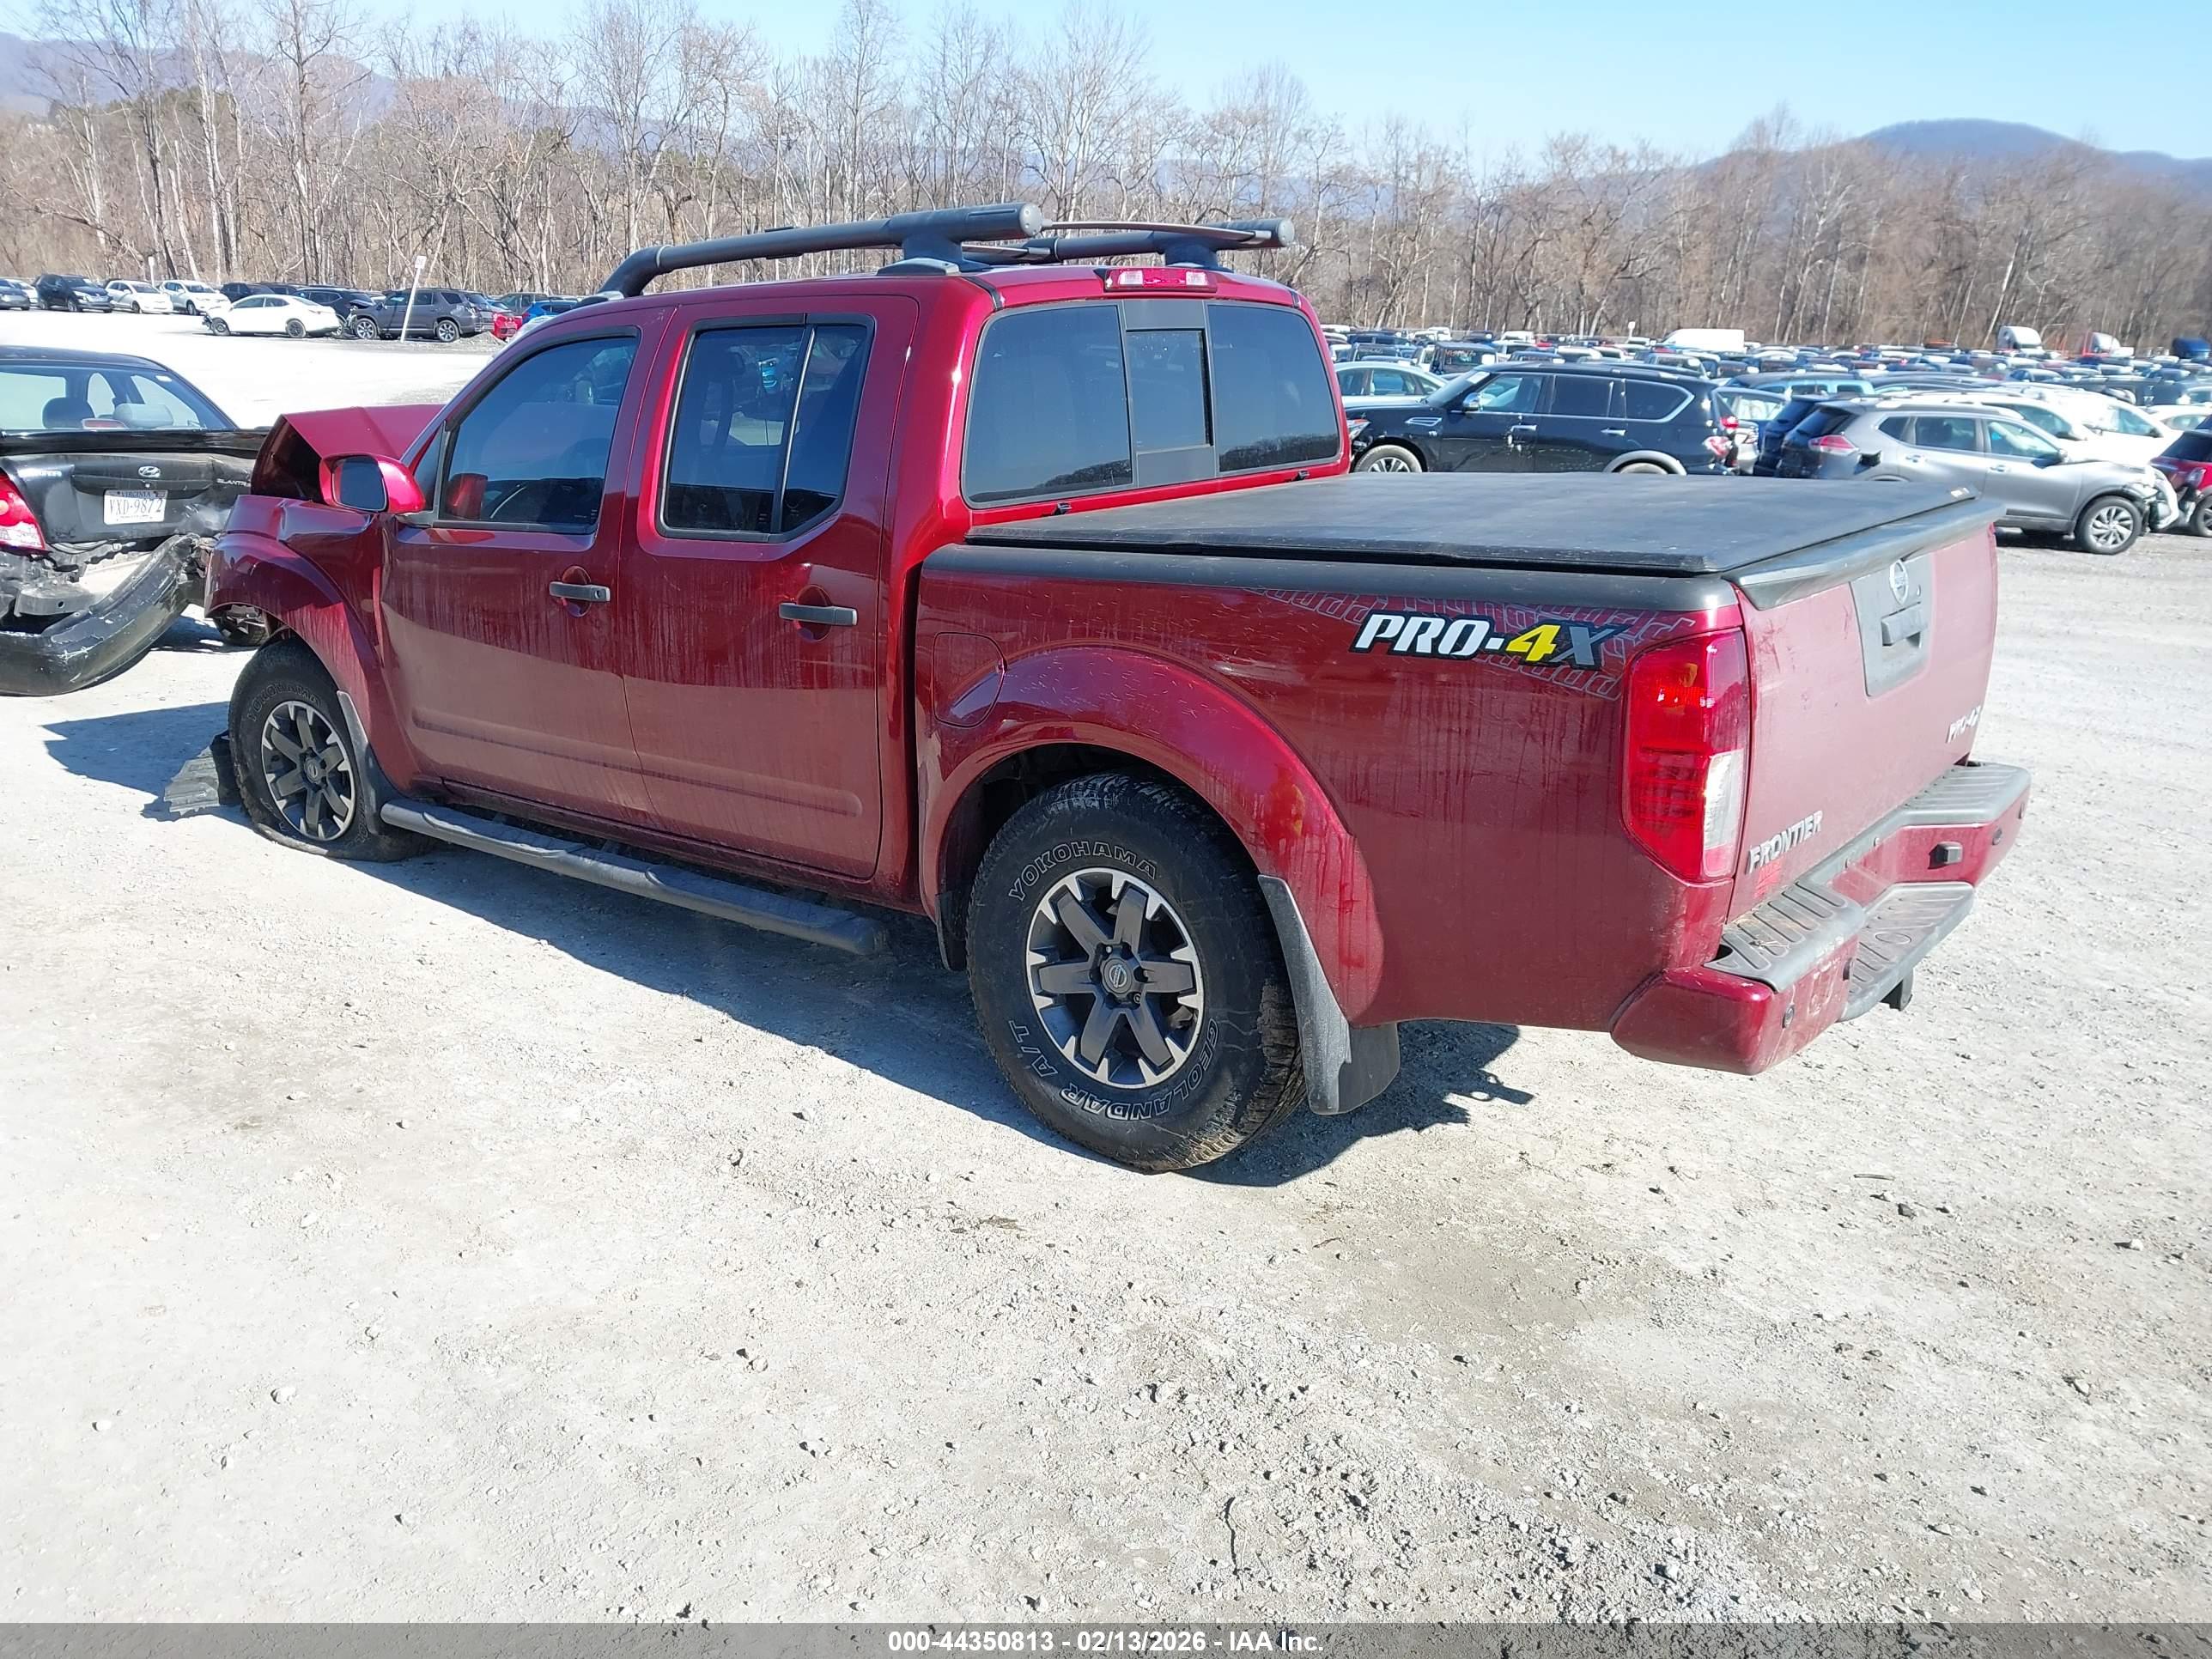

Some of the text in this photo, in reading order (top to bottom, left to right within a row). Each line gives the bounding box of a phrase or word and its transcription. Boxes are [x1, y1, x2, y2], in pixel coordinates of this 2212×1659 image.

[109, 498, 163, 515] VXD-9872
[121, 489, 153, 499] VIRGINIA
[1352, 611, 1628, 668] PRO-4X
[1008, 841, 1157, 901] YOKOHAMA
[1747, 810, 1823, 874] FRONTIER
[1008, 1018, 1219, 1121] GEOLANDAR A/T
